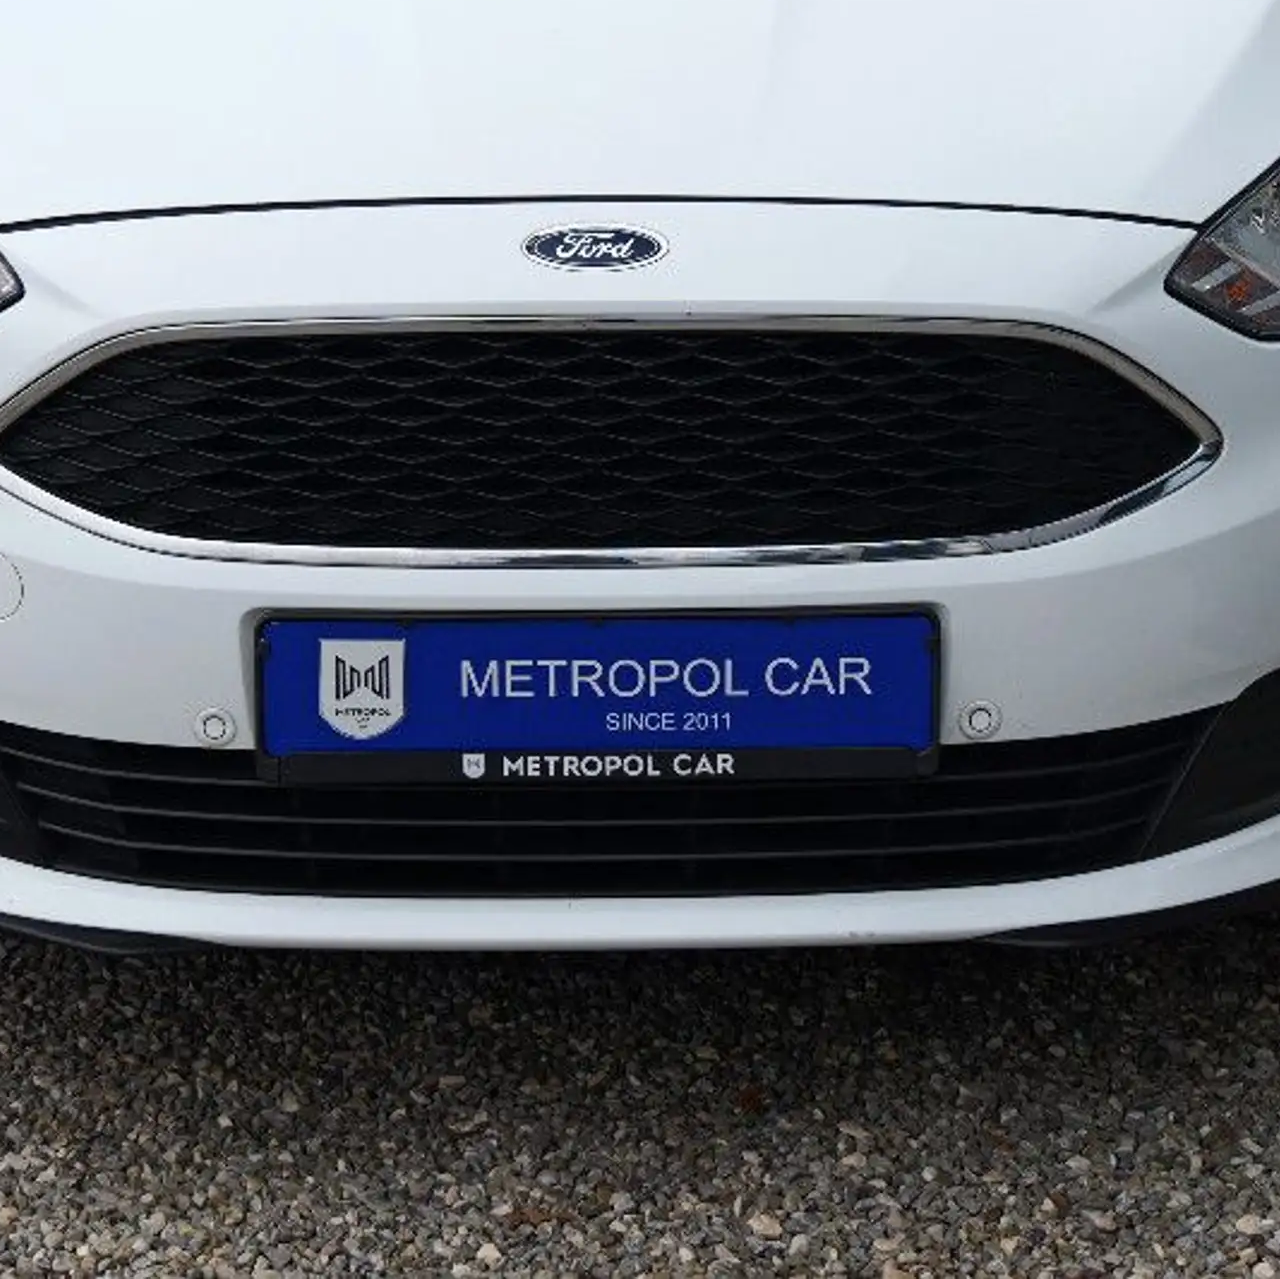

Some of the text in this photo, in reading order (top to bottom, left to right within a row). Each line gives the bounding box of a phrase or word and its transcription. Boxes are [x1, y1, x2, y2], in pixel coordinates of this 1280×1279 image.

[556, 232, 634, 258] Ford
[460, 656, 873, 698] METROPOL CAR
[605, 711, 732, 732] SINCE 2011
[503, 753, 735, 778] METROPOL CAR
